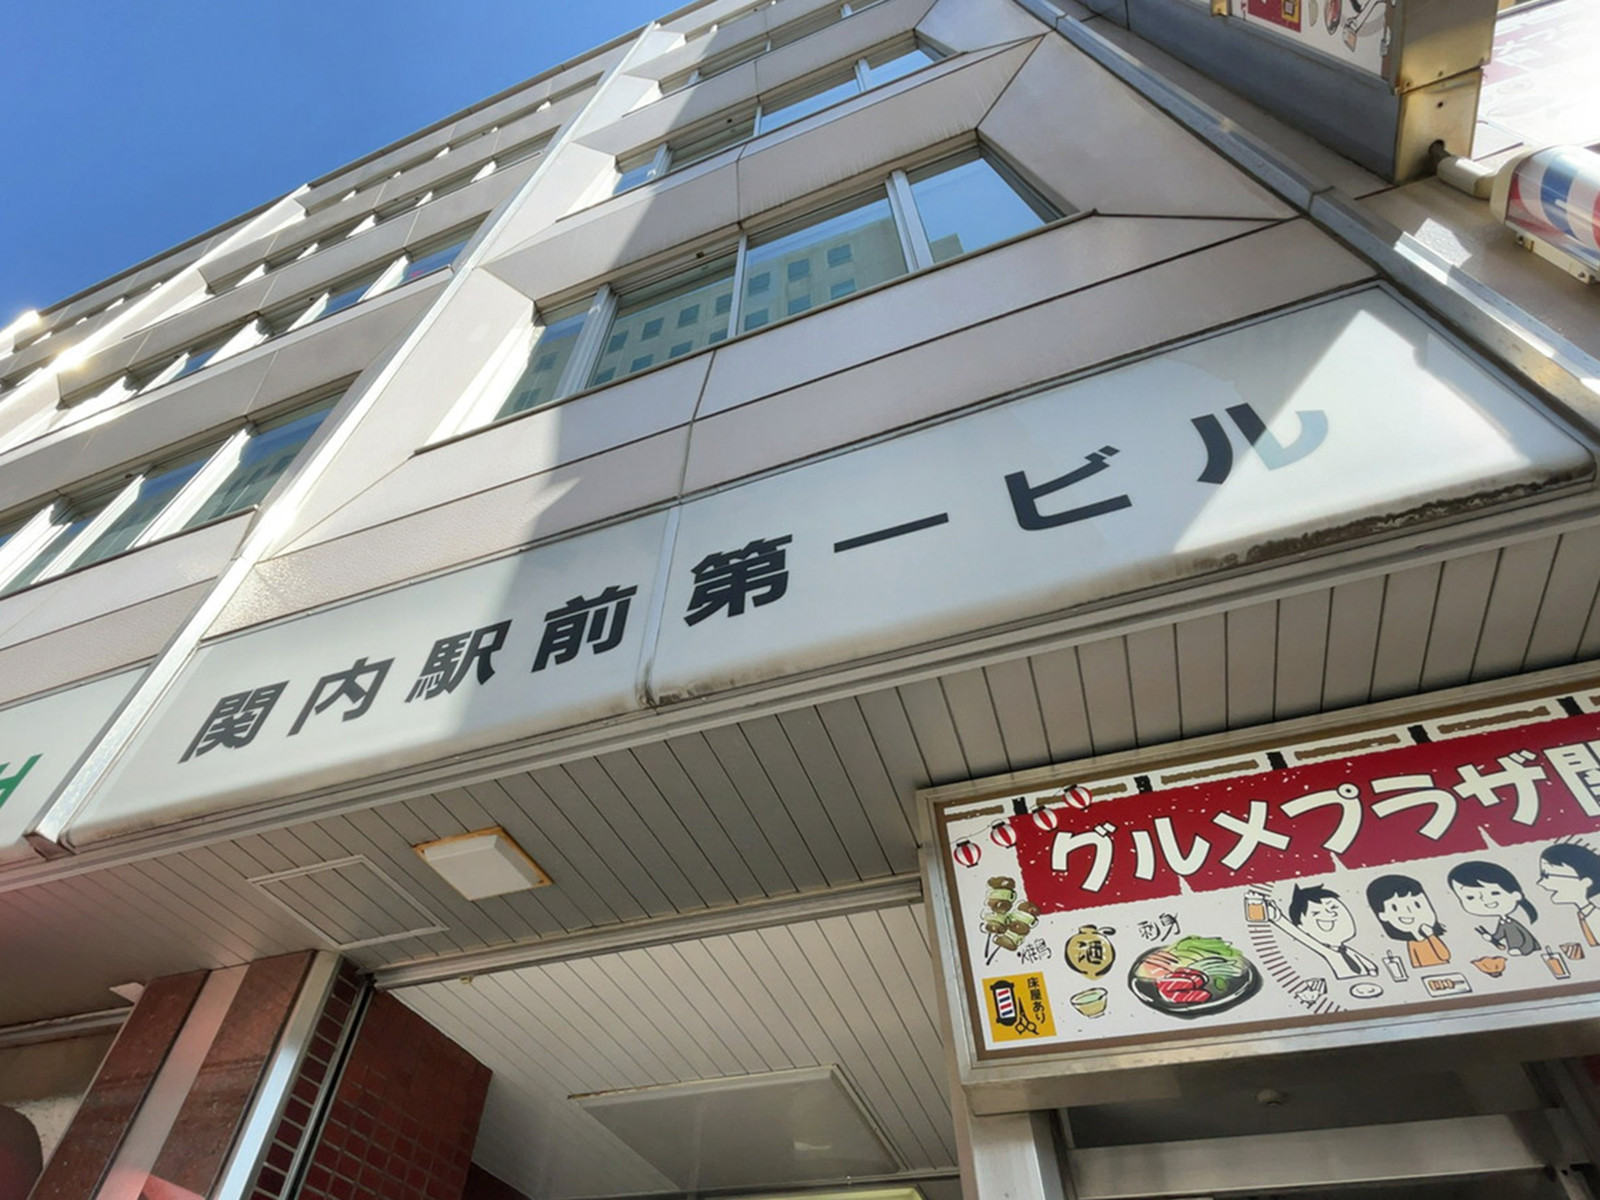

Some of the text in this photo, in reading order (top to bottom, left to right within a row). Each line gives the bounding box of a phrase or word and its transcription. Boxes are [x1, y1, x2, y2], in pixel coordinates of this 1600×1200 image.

[178, 402, 1329, 764] 関内駅前第一ビル
[1137, 912, 1181, 942] 刺身
[1017, 938, 1052, 965] 焼鳥
[1078, 939, 1103, 965] 酒
[1027, 976, 1046, 1024] 床屋あり
